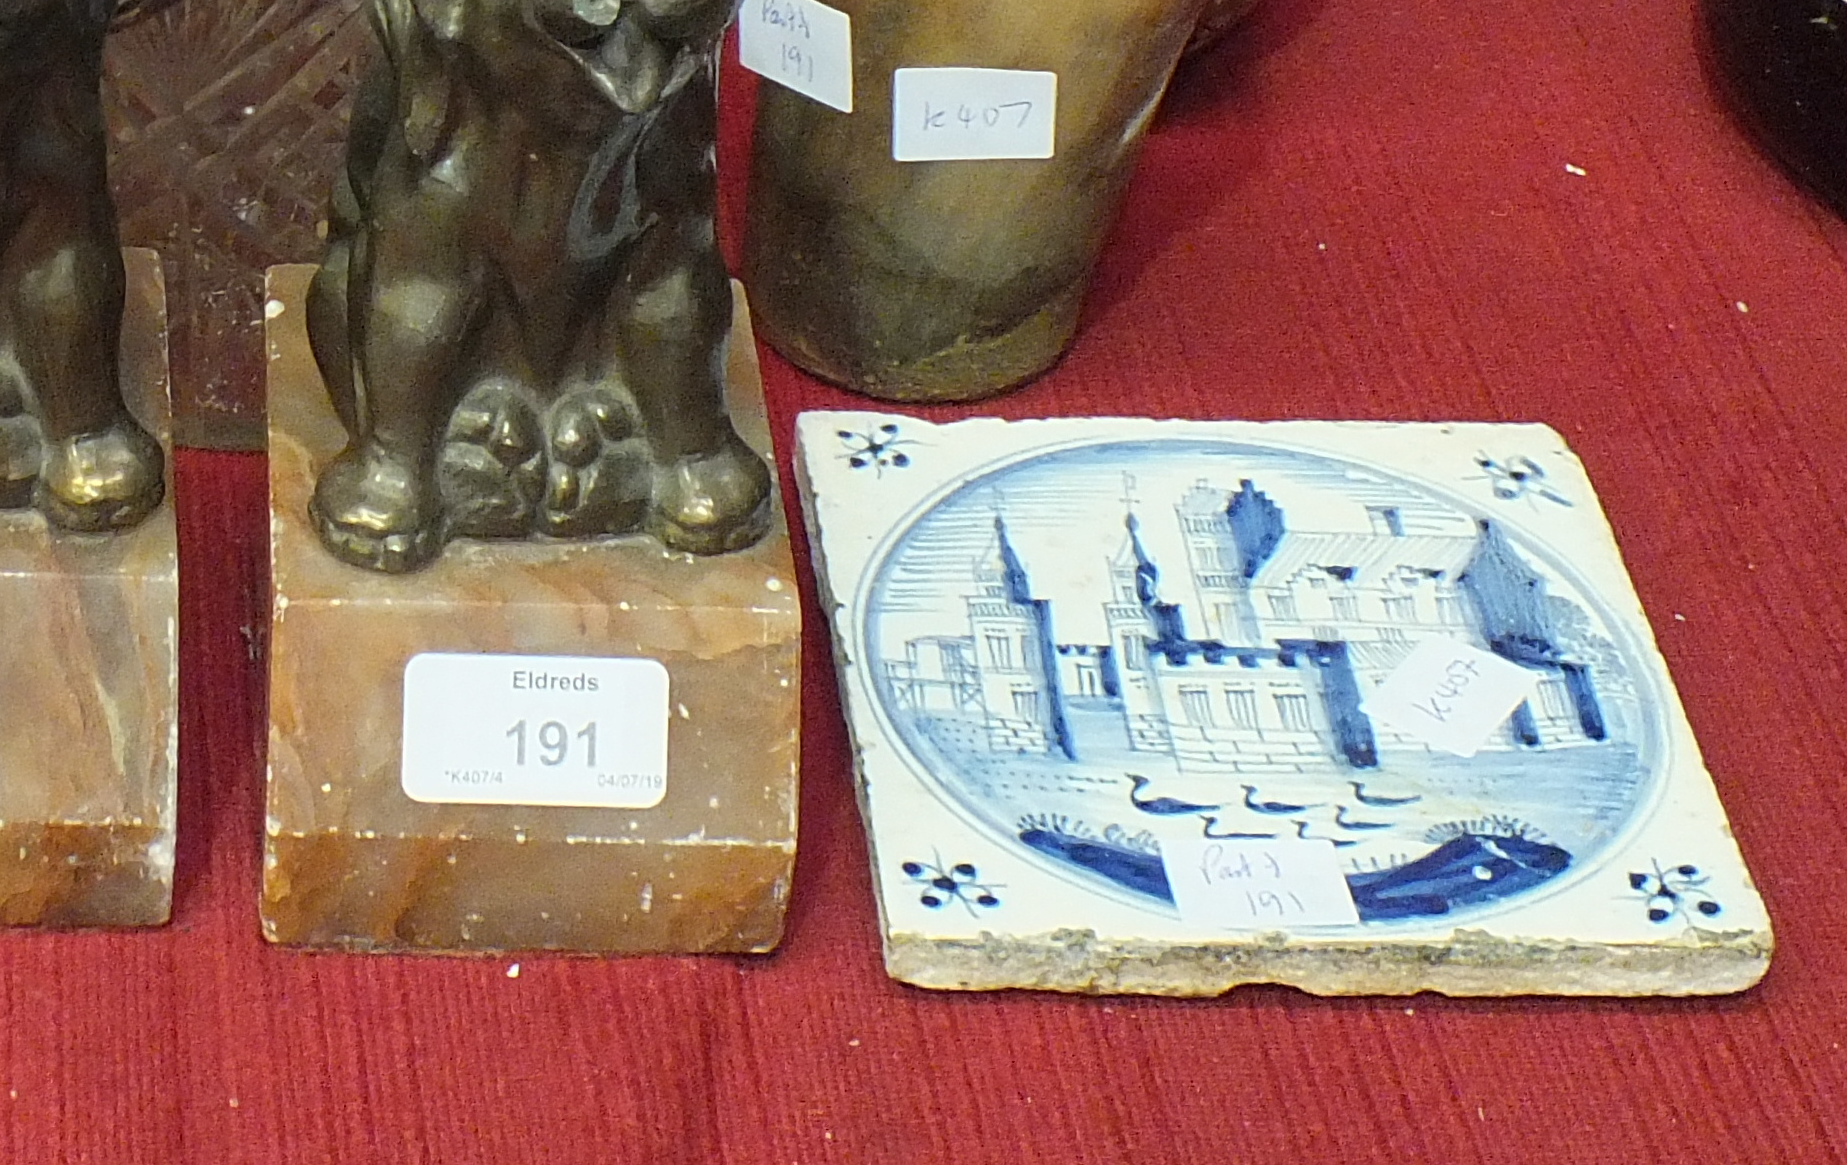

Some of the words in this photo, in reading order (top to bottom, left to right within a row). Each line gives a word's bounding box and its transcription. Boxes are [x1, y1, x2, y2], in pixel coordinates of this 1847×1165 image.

[781, 42, 814, 83] 191
[512, 670, 601, 692] Eldreds
[505, 718, 599, 769] 191
[596, 773, 663, 790] 04/07/19
[1245, 889, 1306, 917] 191
